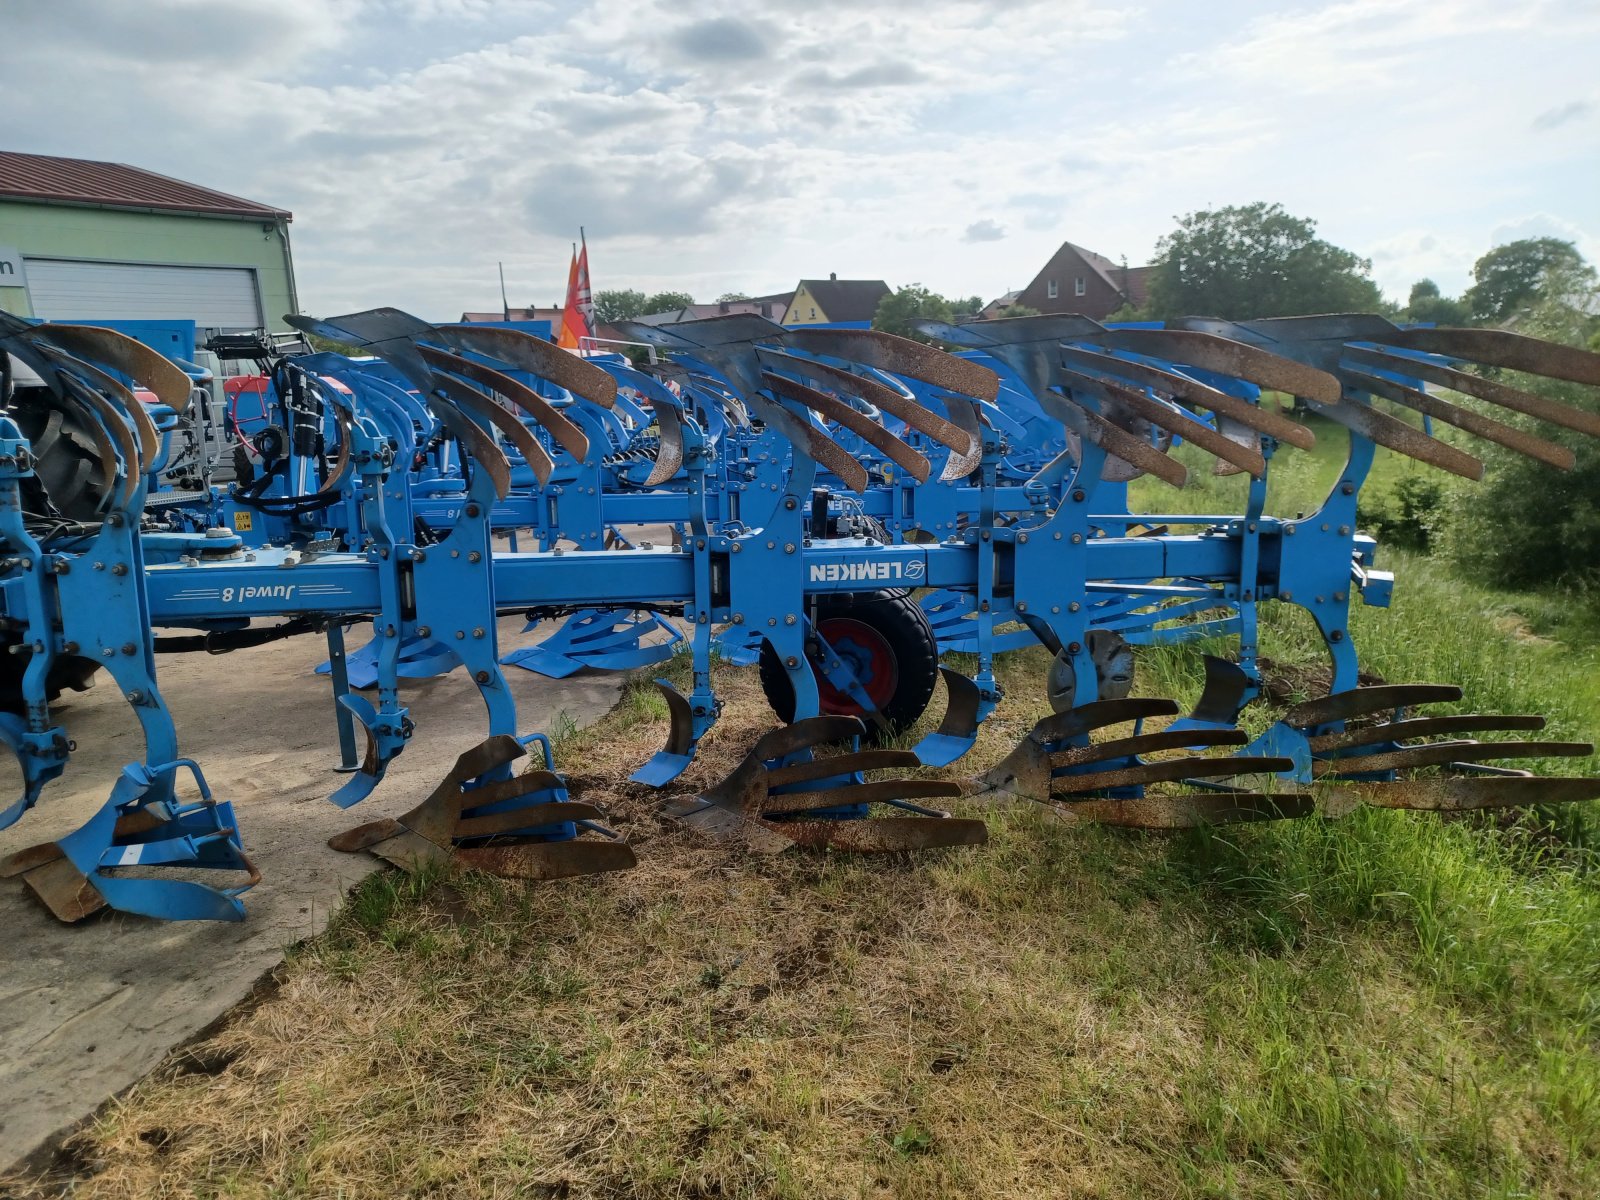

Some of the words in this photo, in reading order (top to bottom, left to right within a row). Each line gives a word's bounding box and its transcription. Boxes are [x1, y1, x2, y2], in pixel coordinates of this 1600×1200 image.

[810, 559, 902, 581] LEMKEN
[222, 587, 234, 602] 8
[238, 585, 296, 602] Juwel
